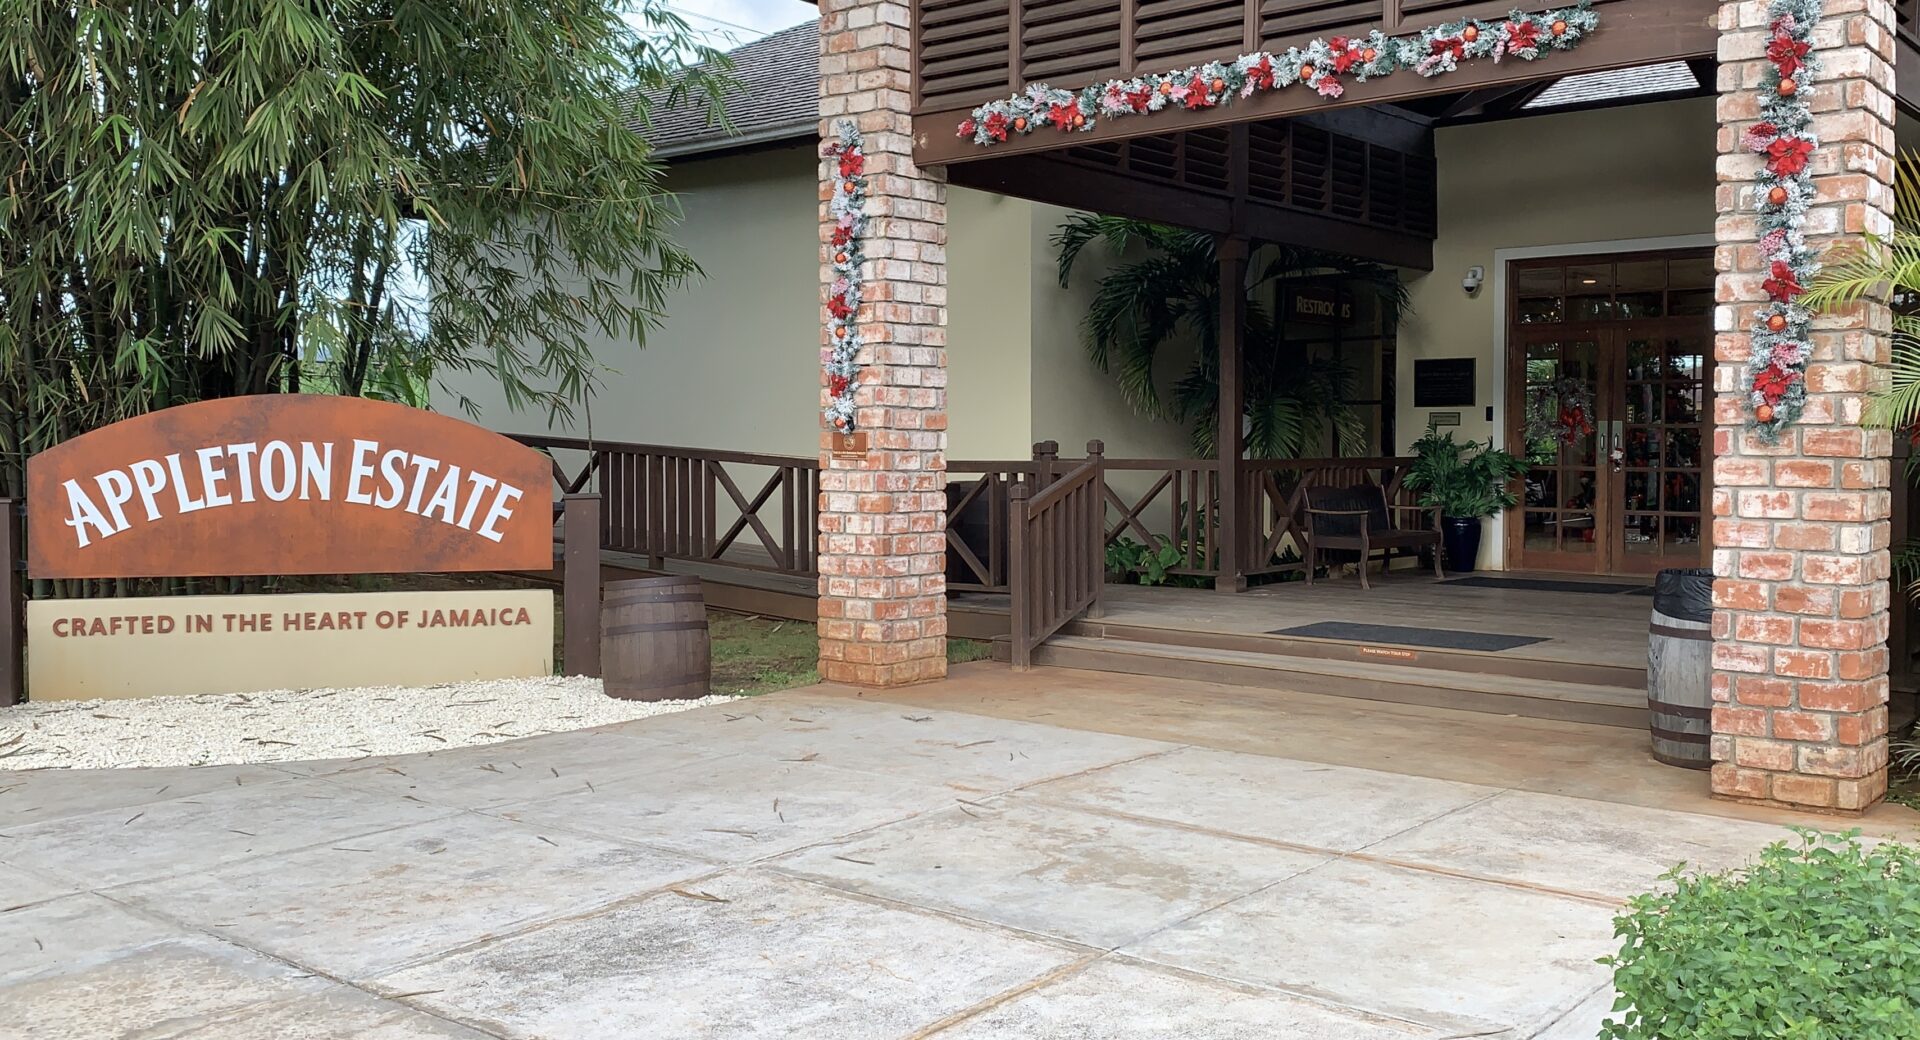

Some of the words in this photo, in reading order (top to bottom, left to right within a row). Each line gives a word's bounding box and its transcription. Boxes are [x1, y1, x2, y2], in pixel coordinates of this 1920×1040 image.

[61, 440, 334, 548] APPLETON
[344, 439, 524, 543] ESTATE
[52, 615, 175, 637] CRAFTED
[186, 614, 213, 633] IN
[222, 613, 272, 632] THE
[283, 611, 367, 631] HEART
[375, 610, 409, 629] OF
[417, 607, 531, 628] JAMAICA
